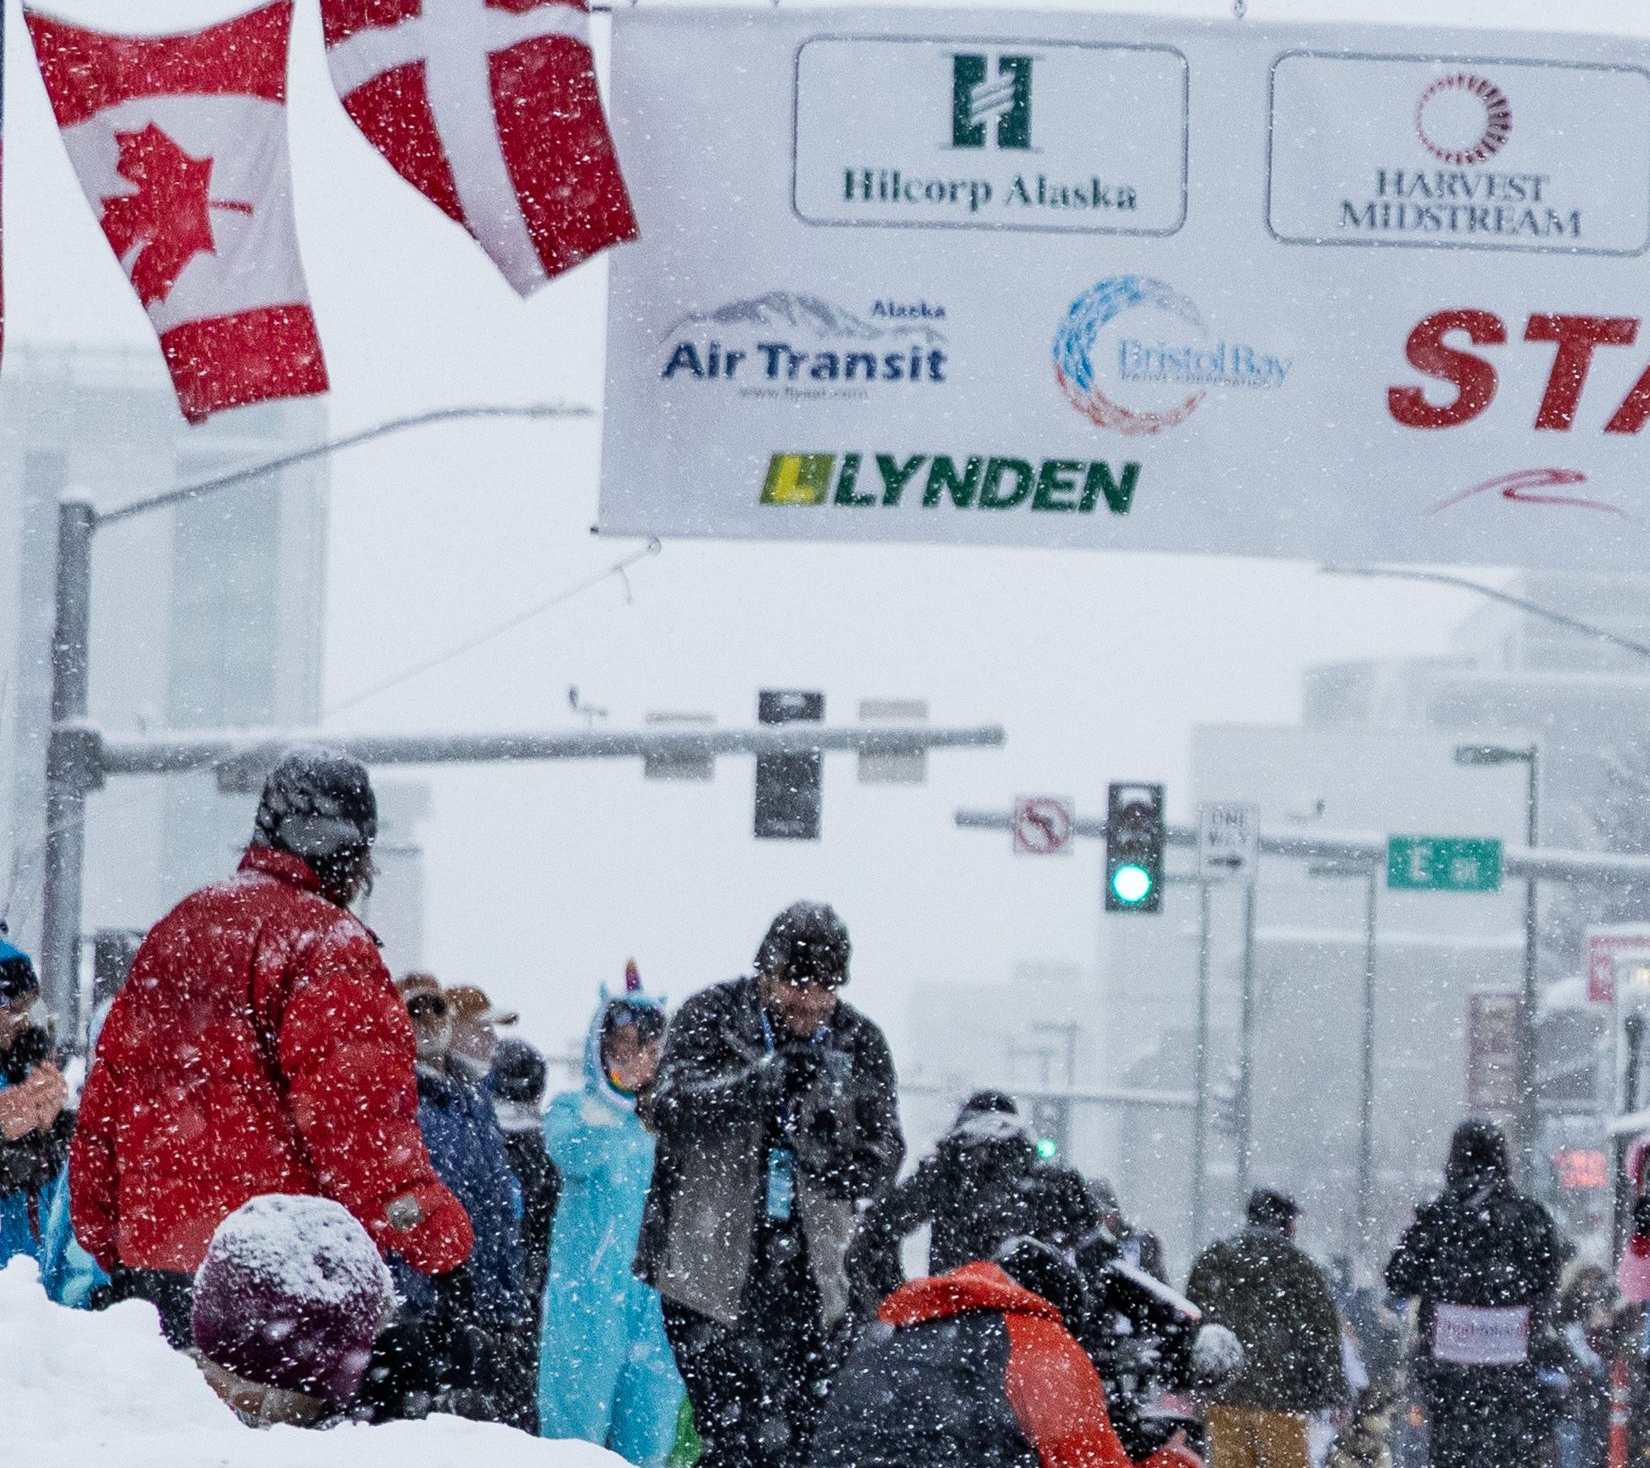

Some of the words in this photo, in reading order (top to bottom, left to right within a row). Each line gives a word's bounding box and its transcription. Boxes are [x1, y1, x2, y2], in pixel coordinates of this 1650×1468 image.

[841, 167, 994, 215] Hilcorp
[1003, 170, 1139, 212] Alaska
[1375, 166, 1550, 202] HARVEST
[1338, 198, 1582, 239] MIDSTREAM
[871, 298, 948, 321] Alaska
[660, 341, 744, 381] Air
[757, 342, 949, 385] Transit
[1118, 339, 1226, 376] Bristol
[1232, 344, 1295, 389] Bay
[833, 452, 1143, 516] LYNDEN
[1409, 845, 1433, 881] E
